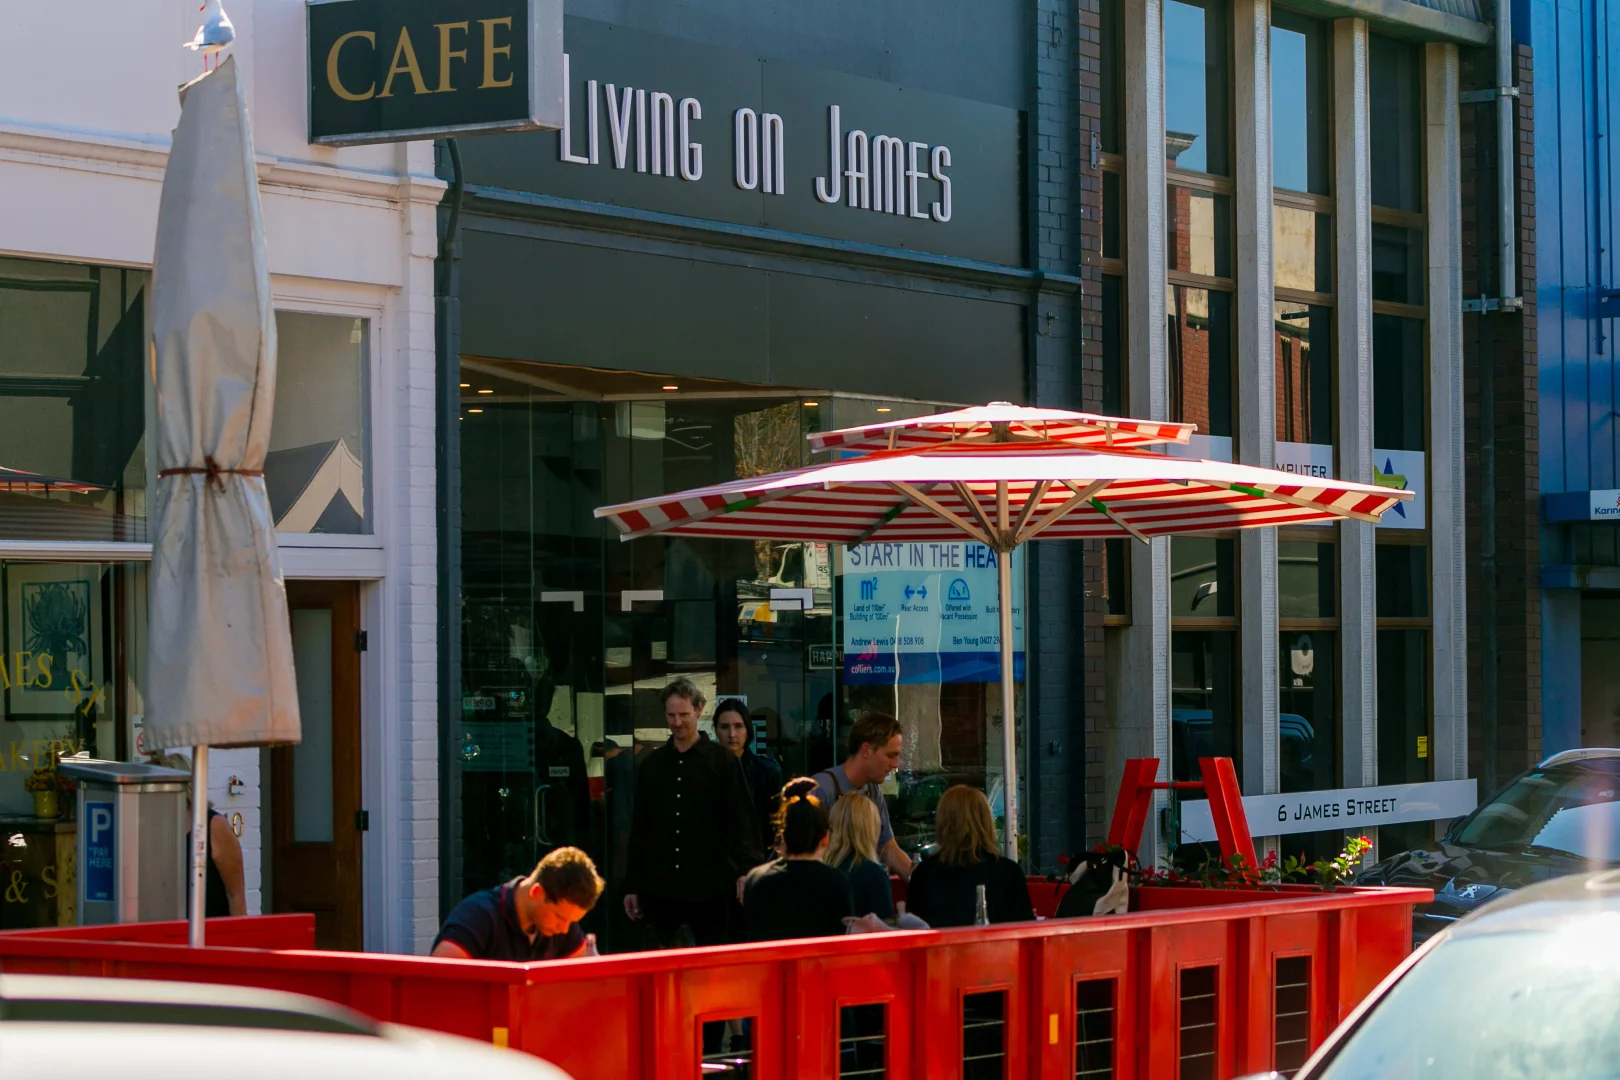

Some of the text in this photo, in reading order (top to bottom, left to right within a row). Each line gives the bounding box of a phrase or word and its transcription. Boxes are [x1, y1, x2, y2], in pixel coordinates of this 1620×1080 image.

[326, 16, 514, 101] CAFE
[815, 105, 952, 223] JAMES
[851, 543, 903, 566] START
[909, 543, 923, 567] IN
[929, 544, 960, 567] THE
[965, 544, 1014, 569] HEAT
[853, 604, 865, 612] Land
[901, 604, 929, 612] Rear Access
[849, 613, 868, 622] Building
[851, 637, 872, 646] Andrew
[873, 637, 889, 646] Lewis
[903, 636, 914, 645] 508
[952, 636, 963, 645] Ben
[963, 636, 979, 647] Young
[979, 636, 992, 645] 0407
[851, 663, 895, 674] colliers.com.au
[1278, 798, 1397, 822] 6 JAMES STREET
[92, 808, 111, 842] P
[5, 870, 28, 903] &
